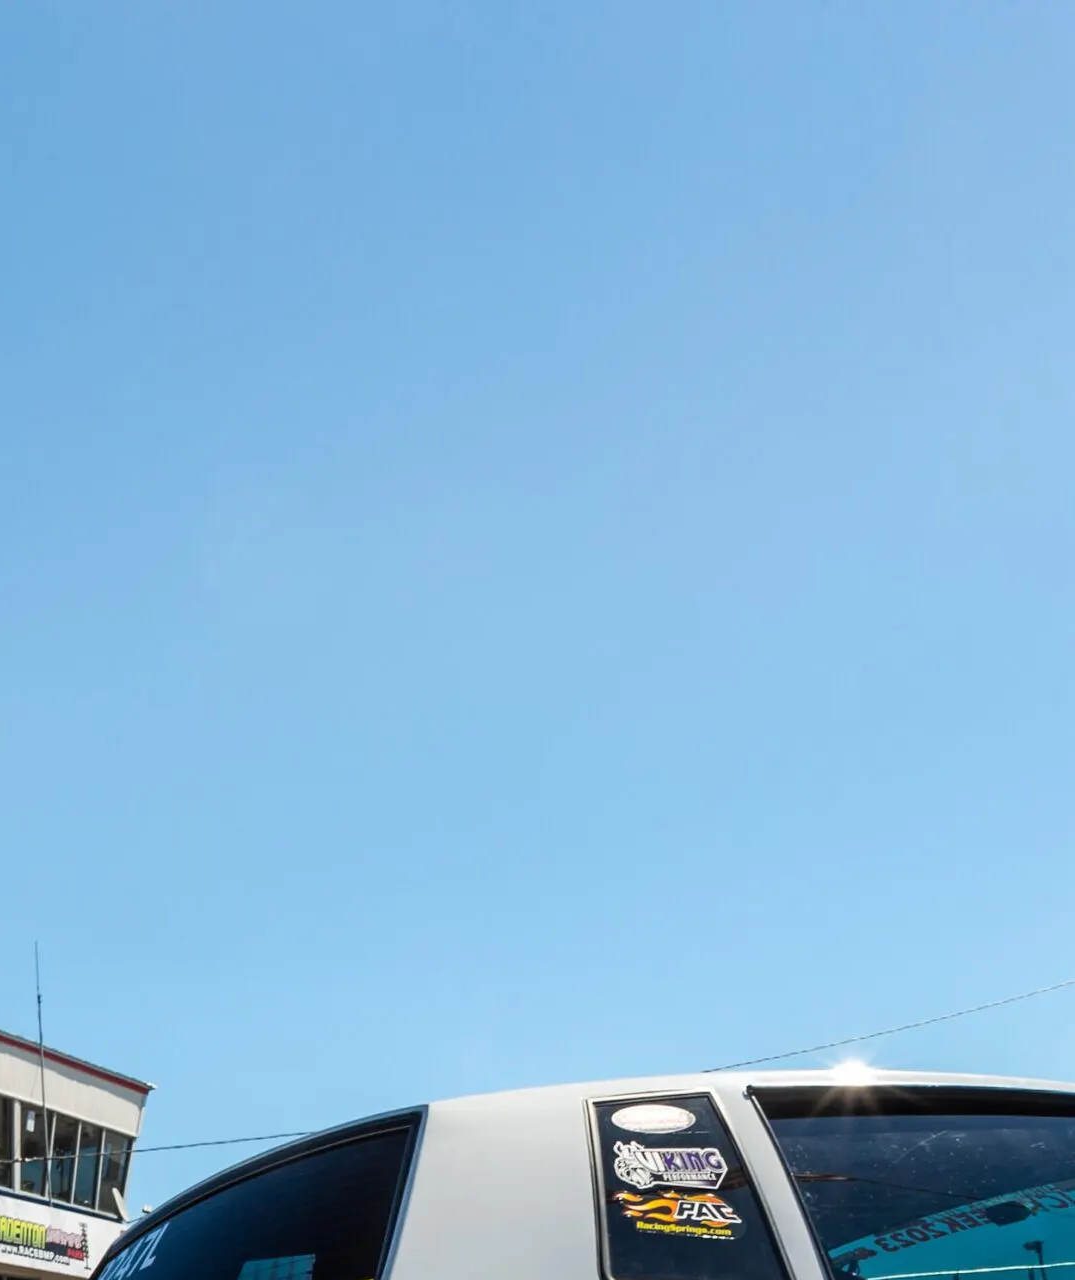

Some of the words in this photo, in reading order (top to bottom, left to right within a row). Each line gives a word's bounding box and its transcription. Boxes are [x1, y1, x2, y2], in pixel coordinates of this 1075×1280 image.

[632, 1150, 723, 1173] VIKING
[663, 1172, 717, 1181] PERFORMANCE
[673, 1200, 742, 1223] PAC
[636, 1221, 732, 1236] RacingSprings.com
